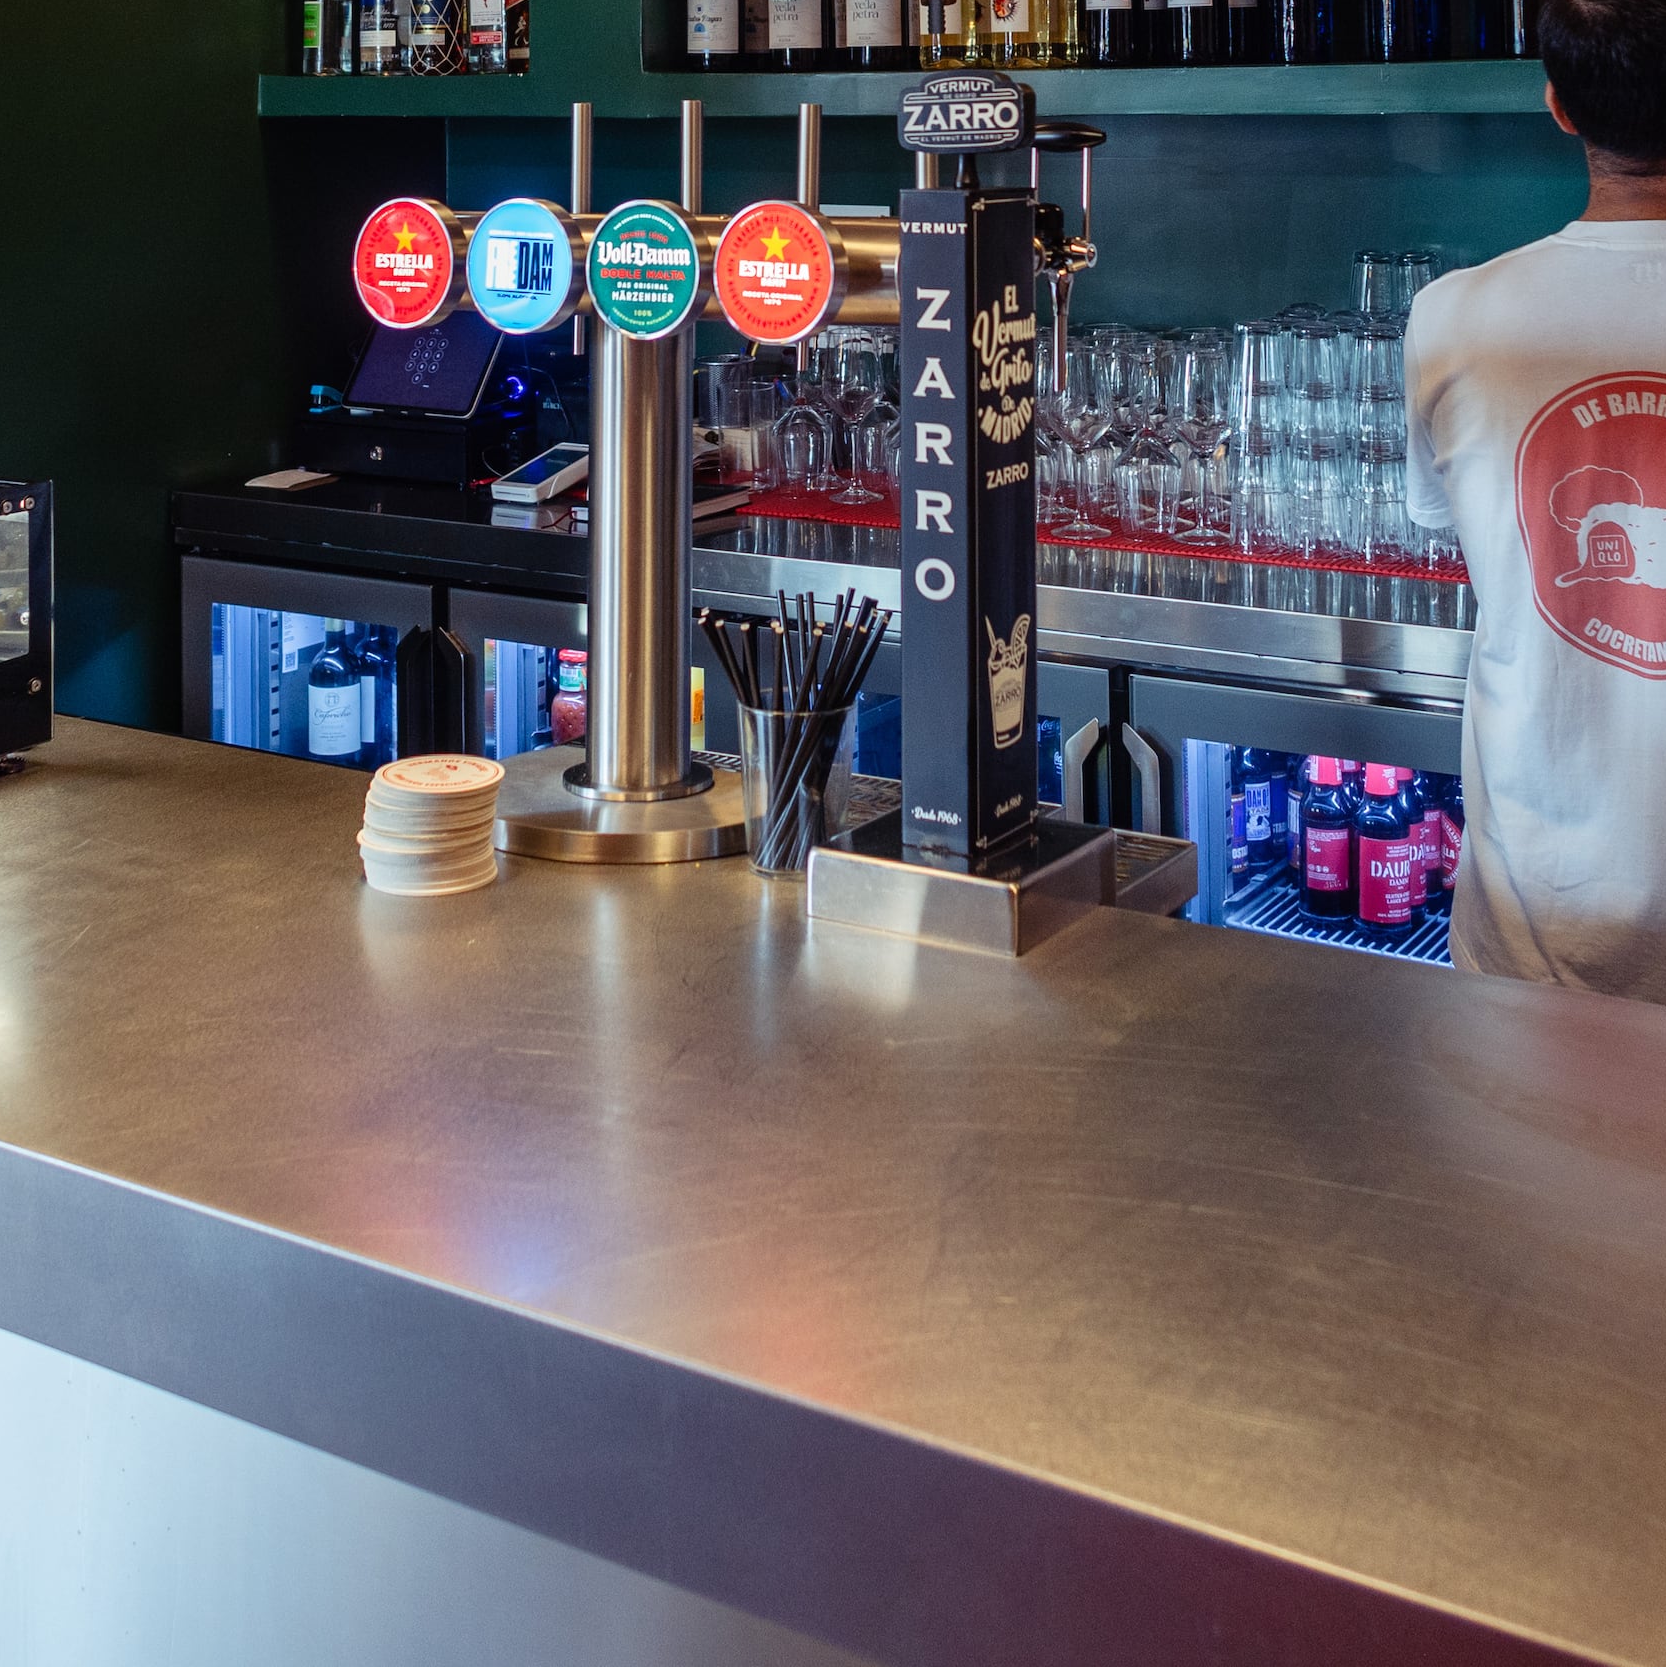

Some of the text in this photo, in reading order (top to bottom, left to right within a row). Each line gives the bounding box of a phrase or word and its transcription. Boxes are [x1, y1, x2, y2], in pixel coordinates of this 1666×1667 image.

[773, 12, 798, 24] petra
[852, 10, 879, 22] petra
[930, 80, 990, 93] VERMUT
[903, 101, 1019, 132] ZARRO
[973, 133, 1002, 141] MADRID
[900, 221, 968, 235] VERMUT
[375, 253, 434, 269] ESTRELLA
[596, 241, 691, 267] Voll-Damm
[600, 268, 686, 281] DOBLE MALTA
[738, 260, 810, 281] ESTRELLA
[617, 281, 669, 291] DAS ORIGINAL
[611, 289, 674, 303] MÄRZENBIER
[1004, 284, 1019, 314] EL
[972, 299, 1036, 367] Vermut
[980, 347, 1033, 397] de Grifo
[979, 397, 1034, 444] MADRID
[1571, 398, 1607, 429] DE
[912, 286, 955, 602] ZARRO
[986, 461, 1029, 490] ZARRO
[1596, 539, 1620, 551] UNI
[1597, 551, 1622, 564] QLO
[995, 684, 1021, 707] ZARRO
[937, 808, 959, 825] 1968
[1370, 859, 1411, 878] DAUR
